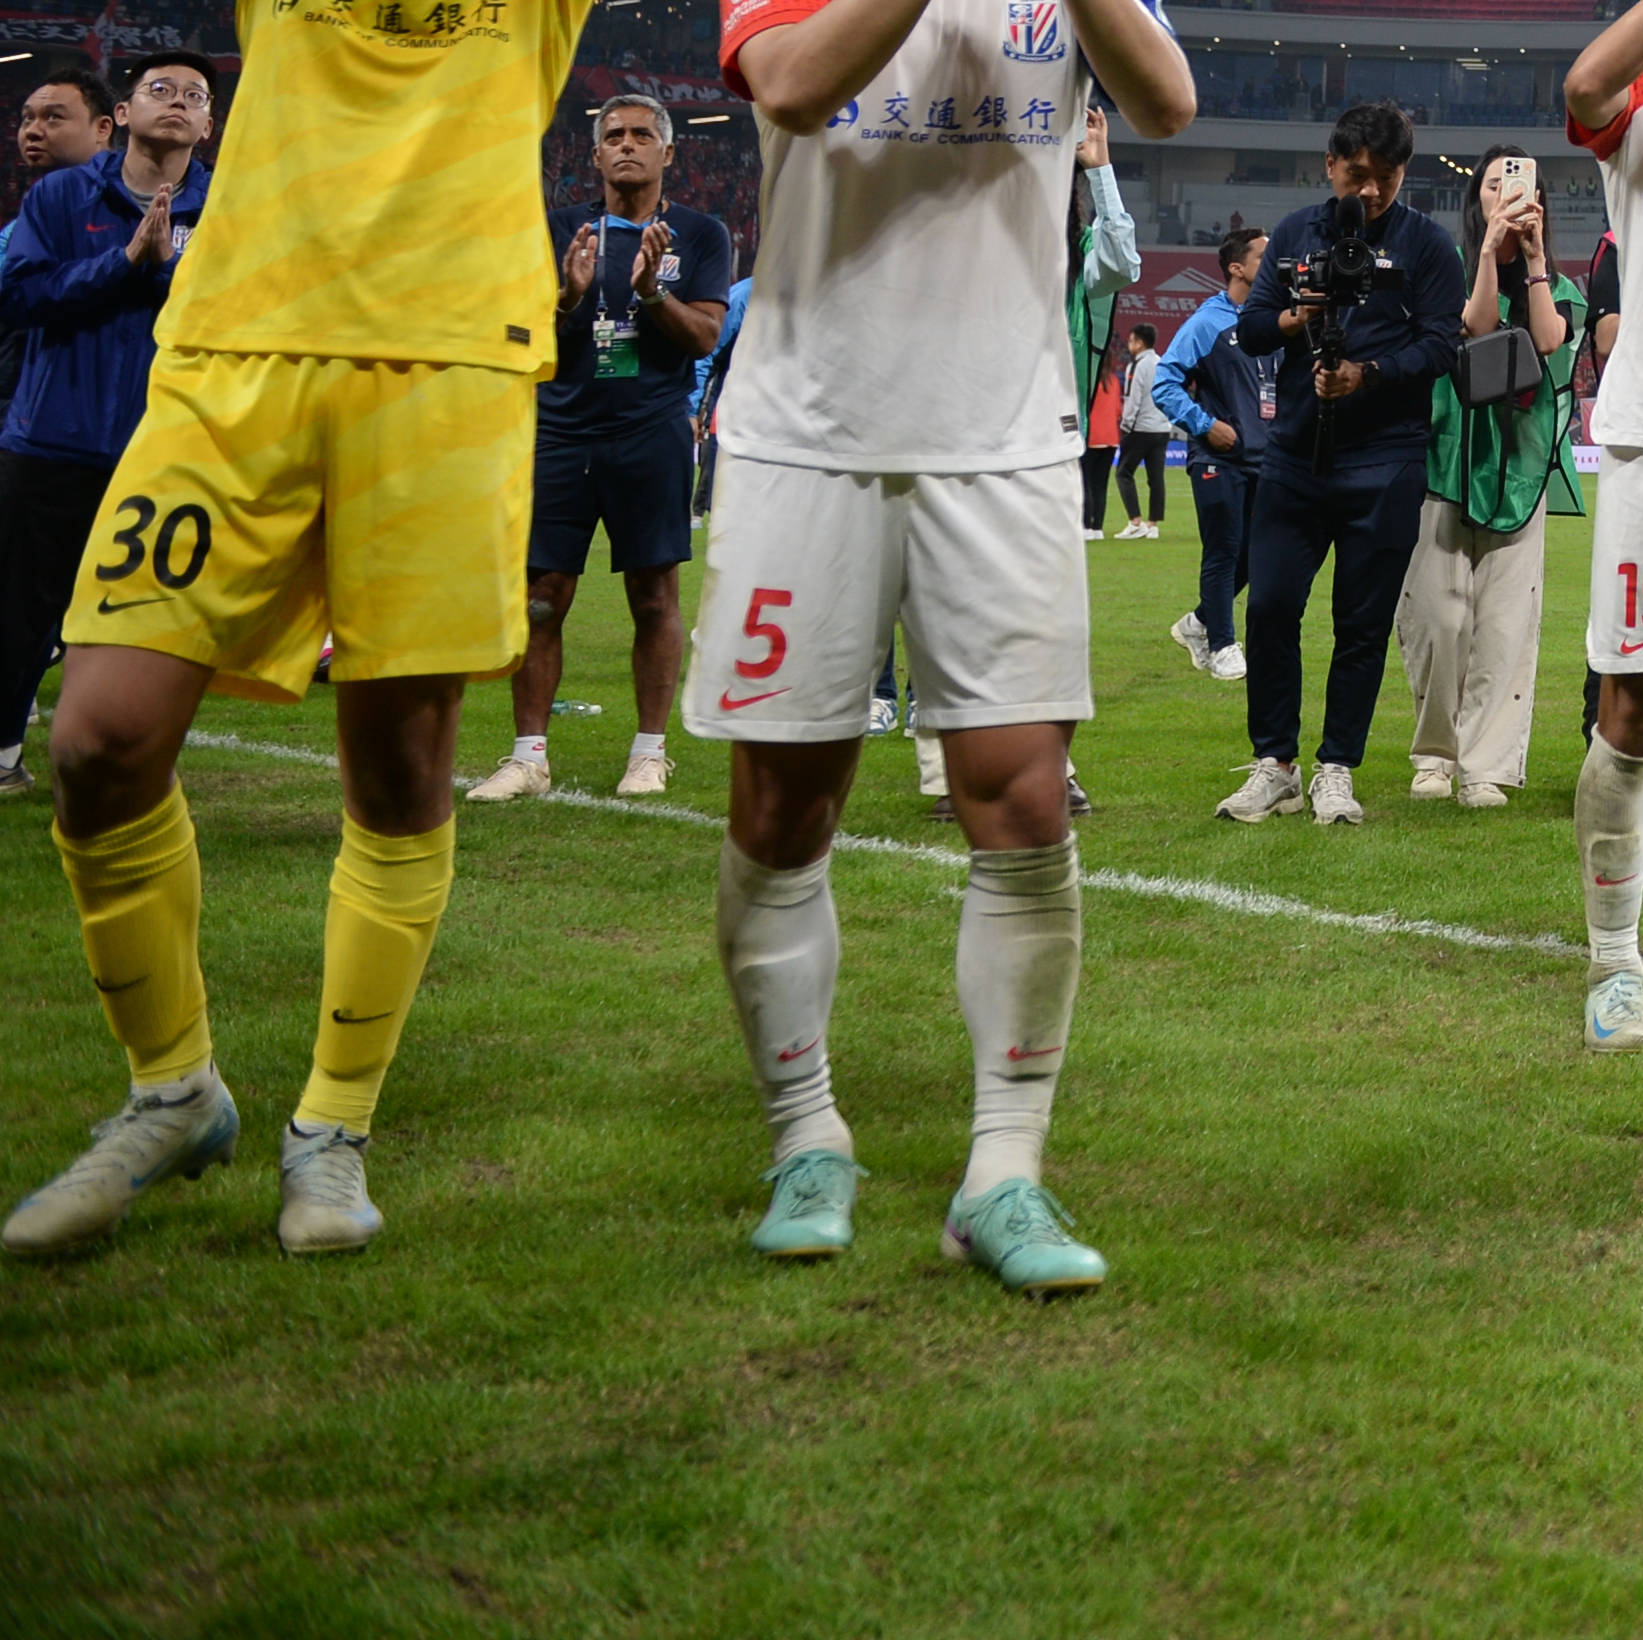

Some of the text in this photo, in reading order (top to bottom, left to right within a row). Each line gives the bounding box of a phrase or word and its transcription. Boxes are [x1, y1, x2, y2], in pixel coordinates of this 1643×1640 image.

[304, 11, 352, 30] BANK
[881, 91, 1057, 131] 交通銀行
[861, 128, 904, 141] BANK
[909, 132, 929, 144] OF
[96, 496, 212, 590] 30
[735, 587, 793, 679] 5
